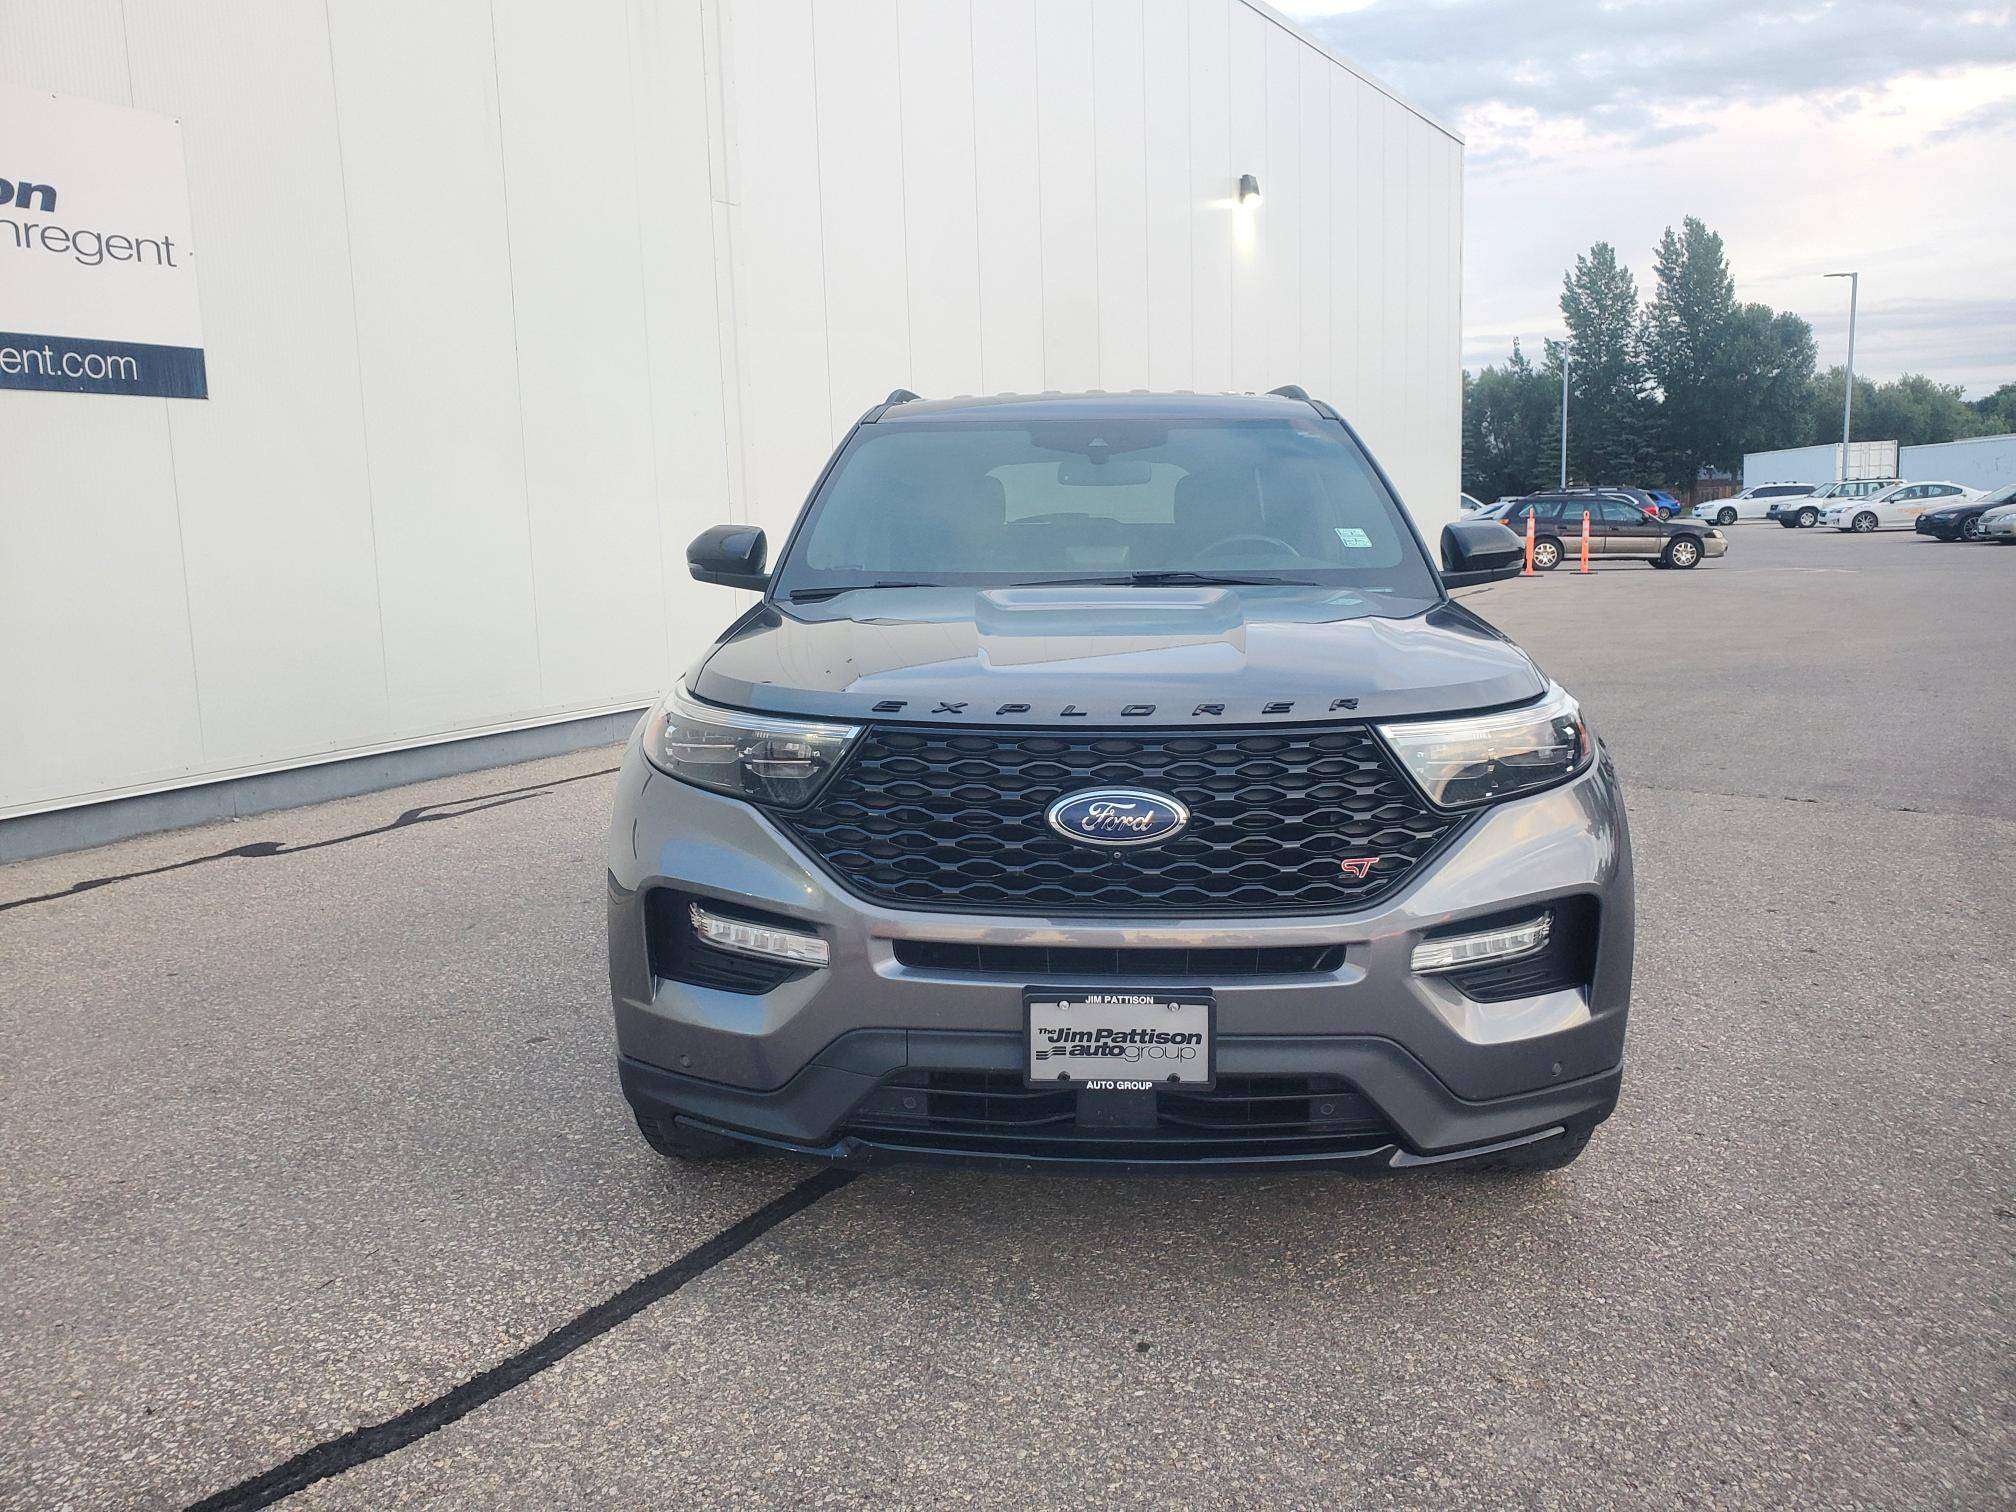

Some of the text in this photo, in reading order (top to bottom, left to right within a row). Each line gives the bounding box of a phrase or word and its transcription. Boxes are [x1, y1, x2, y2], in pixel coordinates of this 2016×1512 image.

[0, 345, 138, 380] ent.com
[872, 698, 1359, 716] EXPLORER
[1081, 801, 1154, 831] Ford
[1341, 857, 1380, 878] ST
[1085, 995, 1154, 1004] JIM PATTISON
[1086, 1080, 1153, 1090] AUTO GROUP
